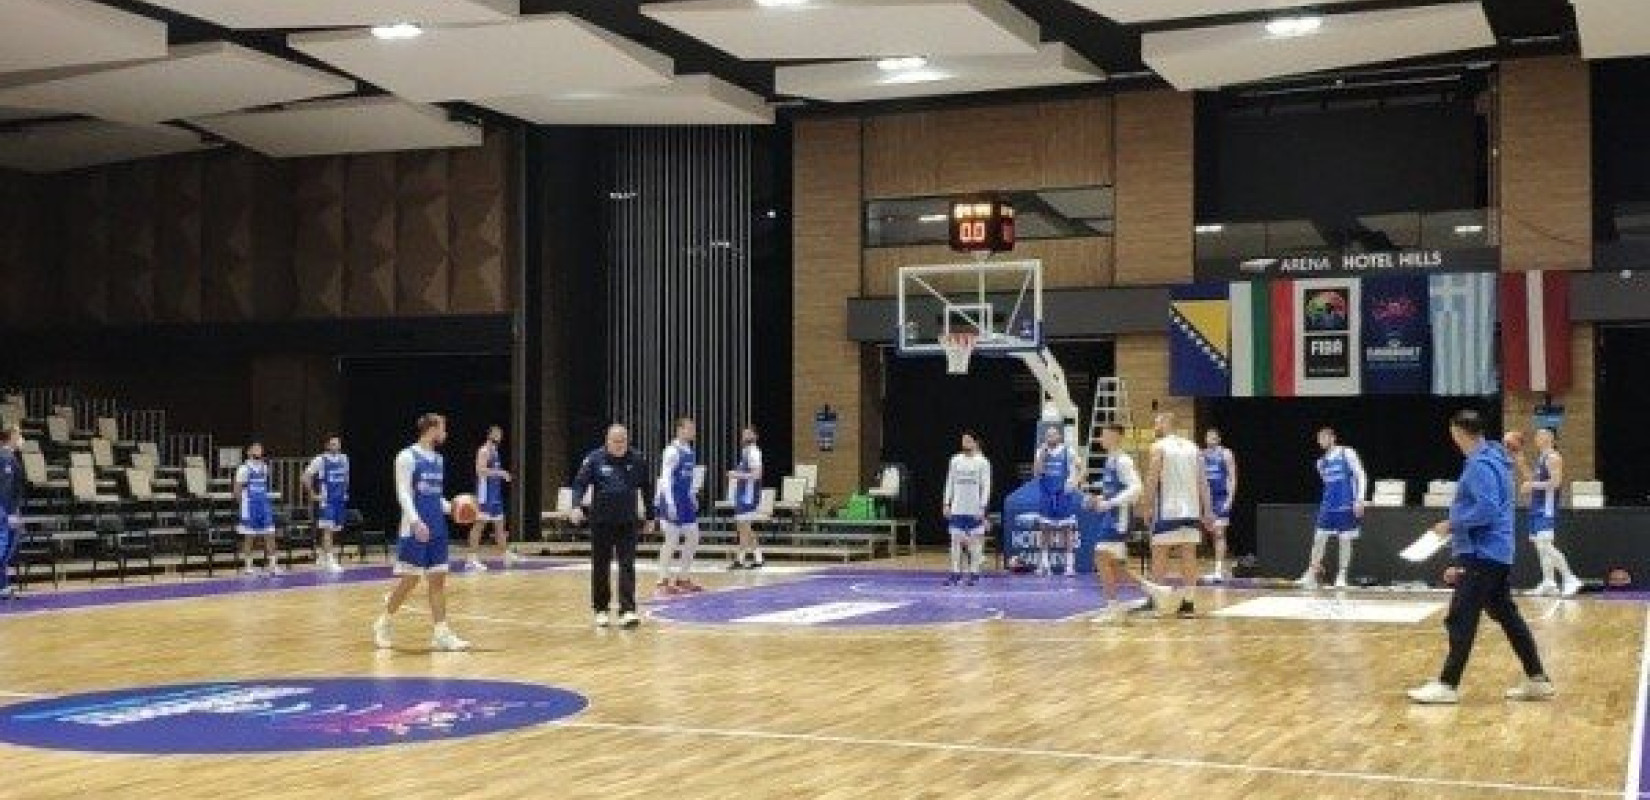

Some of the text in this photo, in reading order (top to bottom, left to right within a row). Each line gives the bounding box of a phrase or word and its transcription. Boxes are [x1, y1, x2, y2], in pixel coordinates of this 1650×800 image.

[1281, 250, 1441, 271] ARENA HOTEL HILLS
[1311, 340, 1342, 355] FIBA
